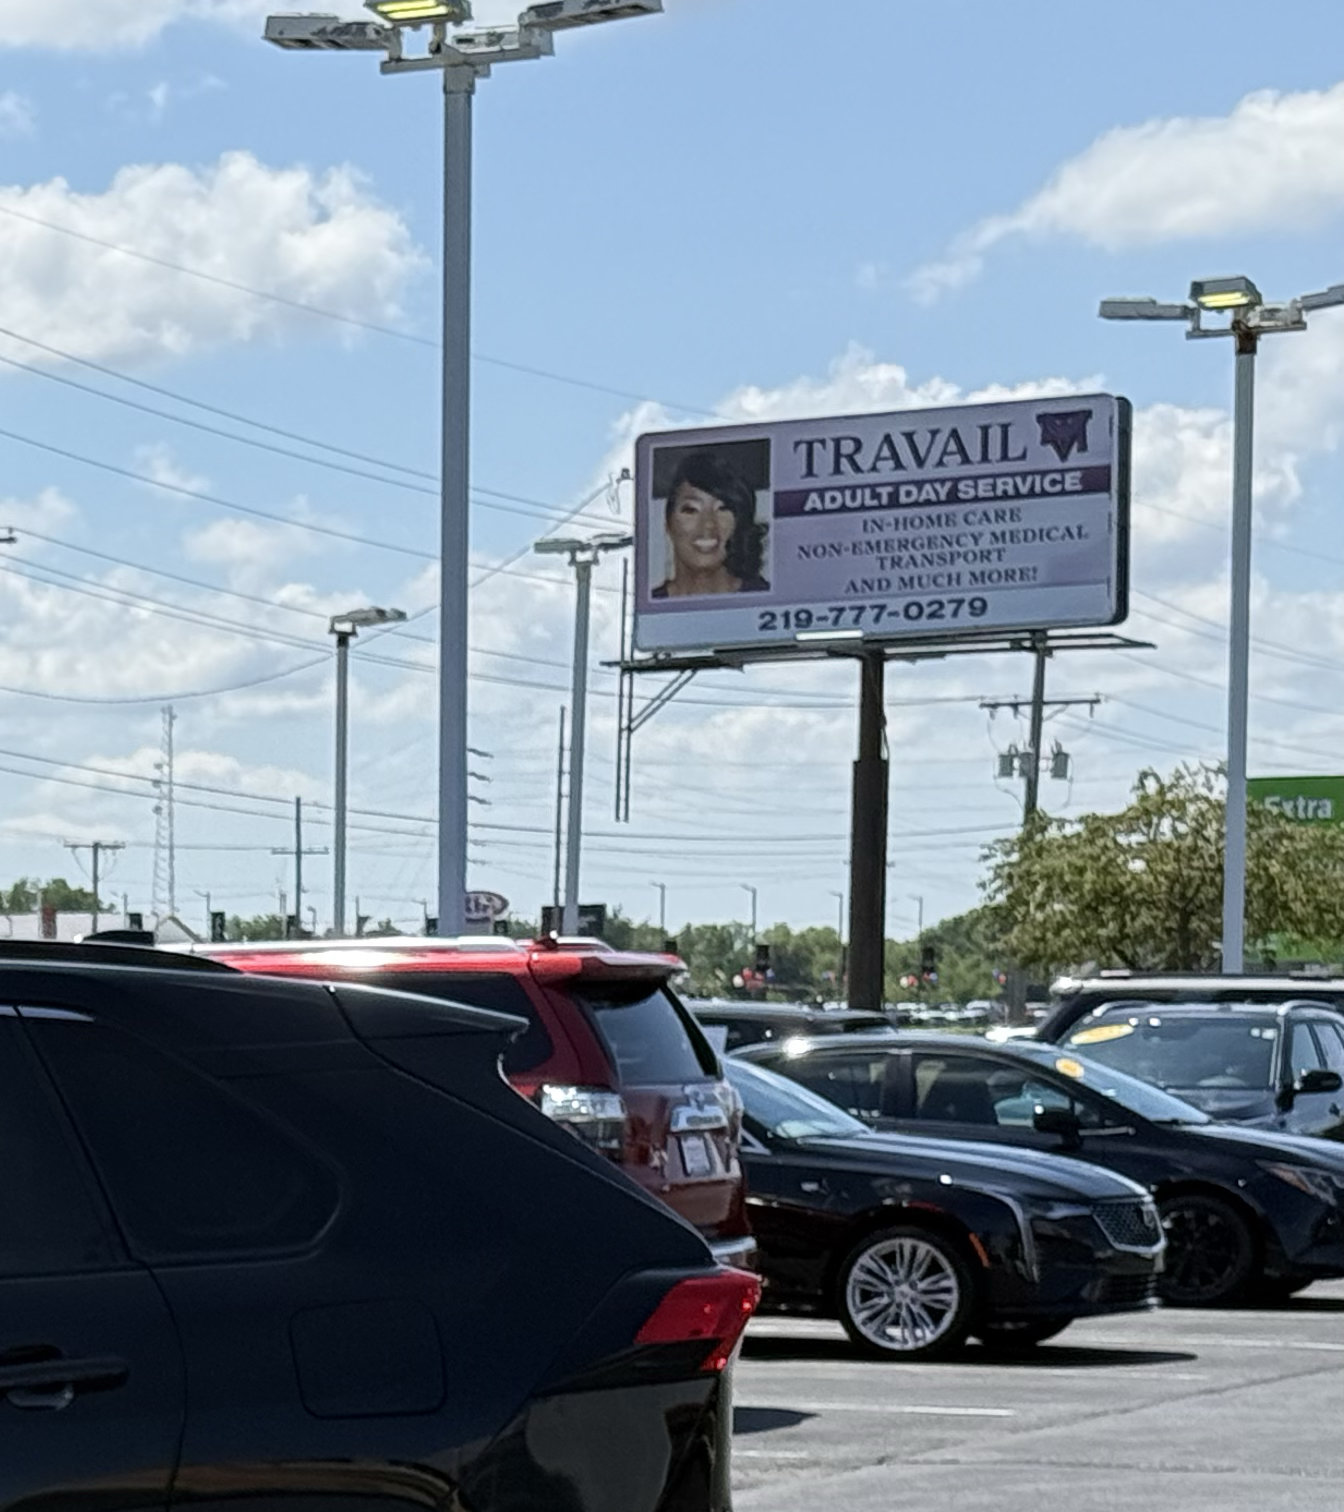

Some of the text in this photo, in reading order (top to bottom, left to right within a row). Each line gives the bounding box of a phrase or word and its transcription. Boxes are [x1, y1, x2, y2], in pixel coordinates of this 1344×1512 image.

[793, 423, 1027, 479] TRAVAIL
[803, 471, 1083, 513] ADULT DAY SERVICE
[862, 507, 1023, 534] IN-HOME CARE
[797, 524, 1089, 560] NON-EMERGENCY MEDICAL
[875, 548, 1006, 571] TRANSPORT
[844, 566, 1039, 595] AND MUCH MORE!
[758, 596, 989, 632] 219-777-0279
[1263, 795, 1332, 820] Extra
